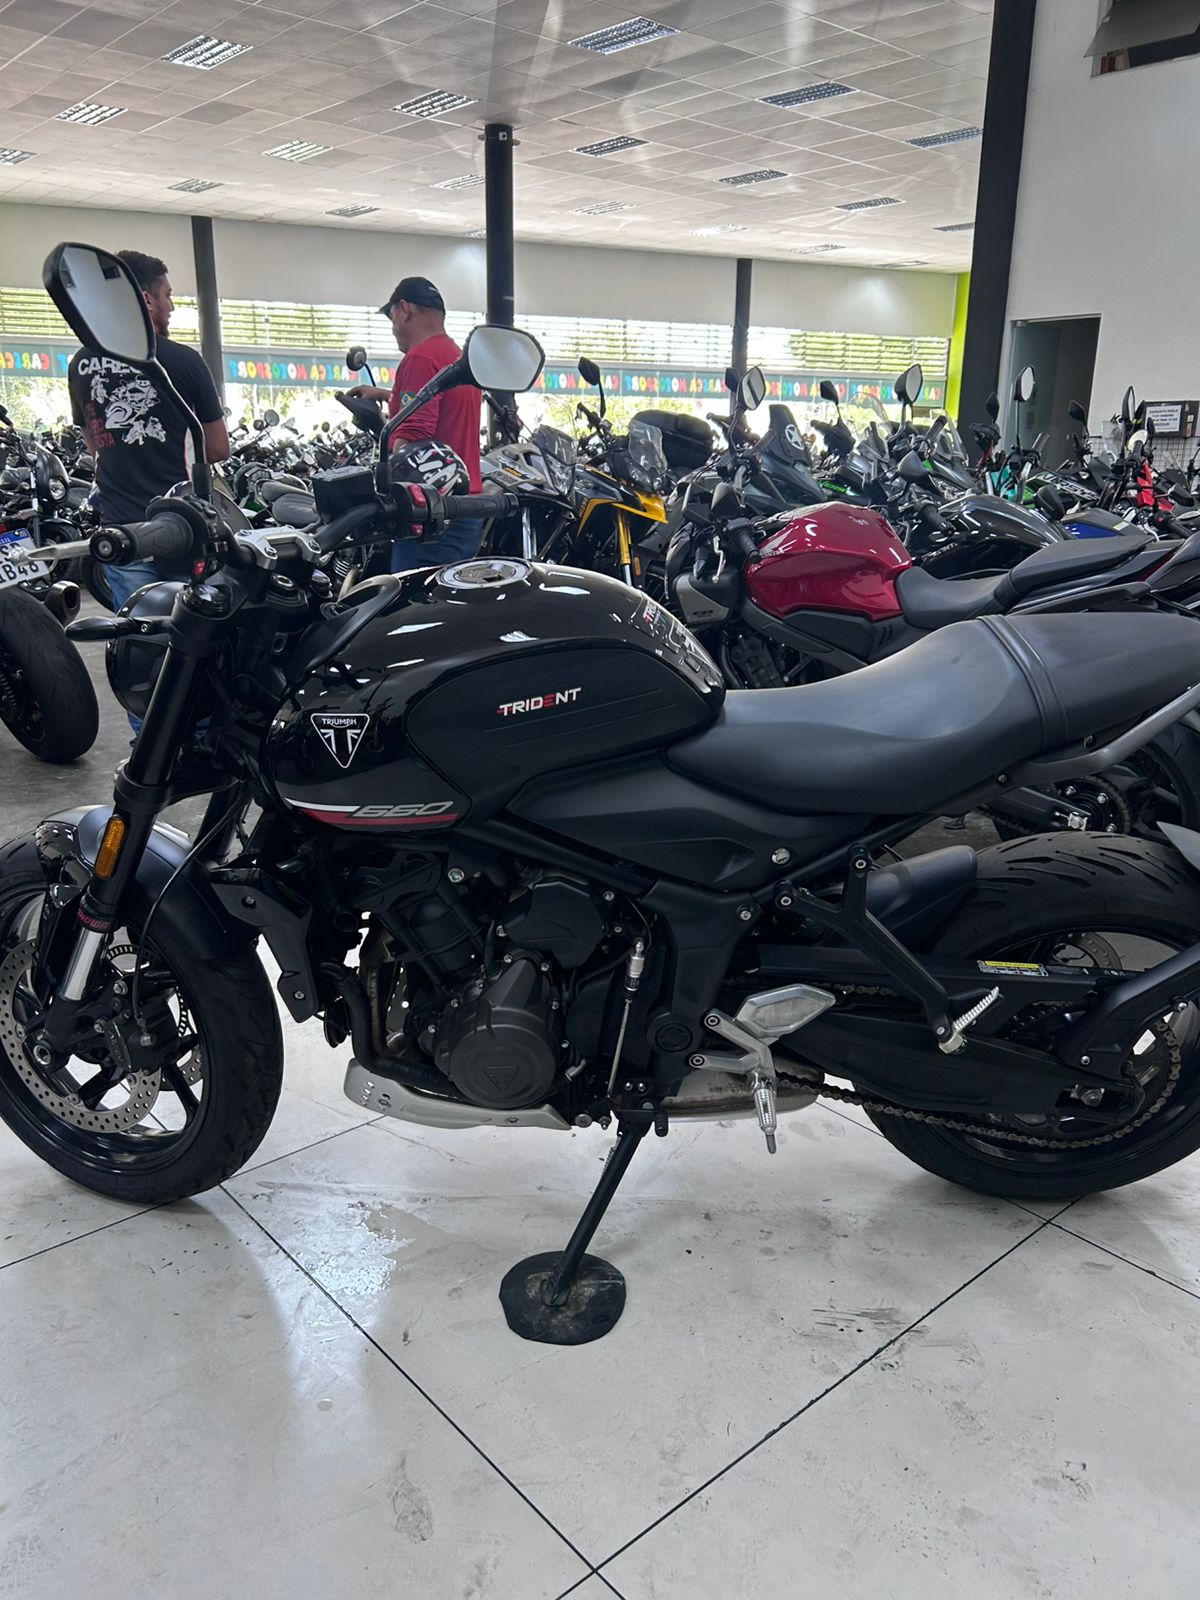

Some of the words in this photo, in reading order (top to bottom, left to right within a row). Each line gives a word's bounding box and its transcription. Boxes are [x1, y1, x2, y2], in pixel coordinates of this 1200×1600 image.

[496, 687, 582, 716] TRIDENT
[322, 718, 357, 726] TRIUMPH
[352, 800, 454, 818] 660
